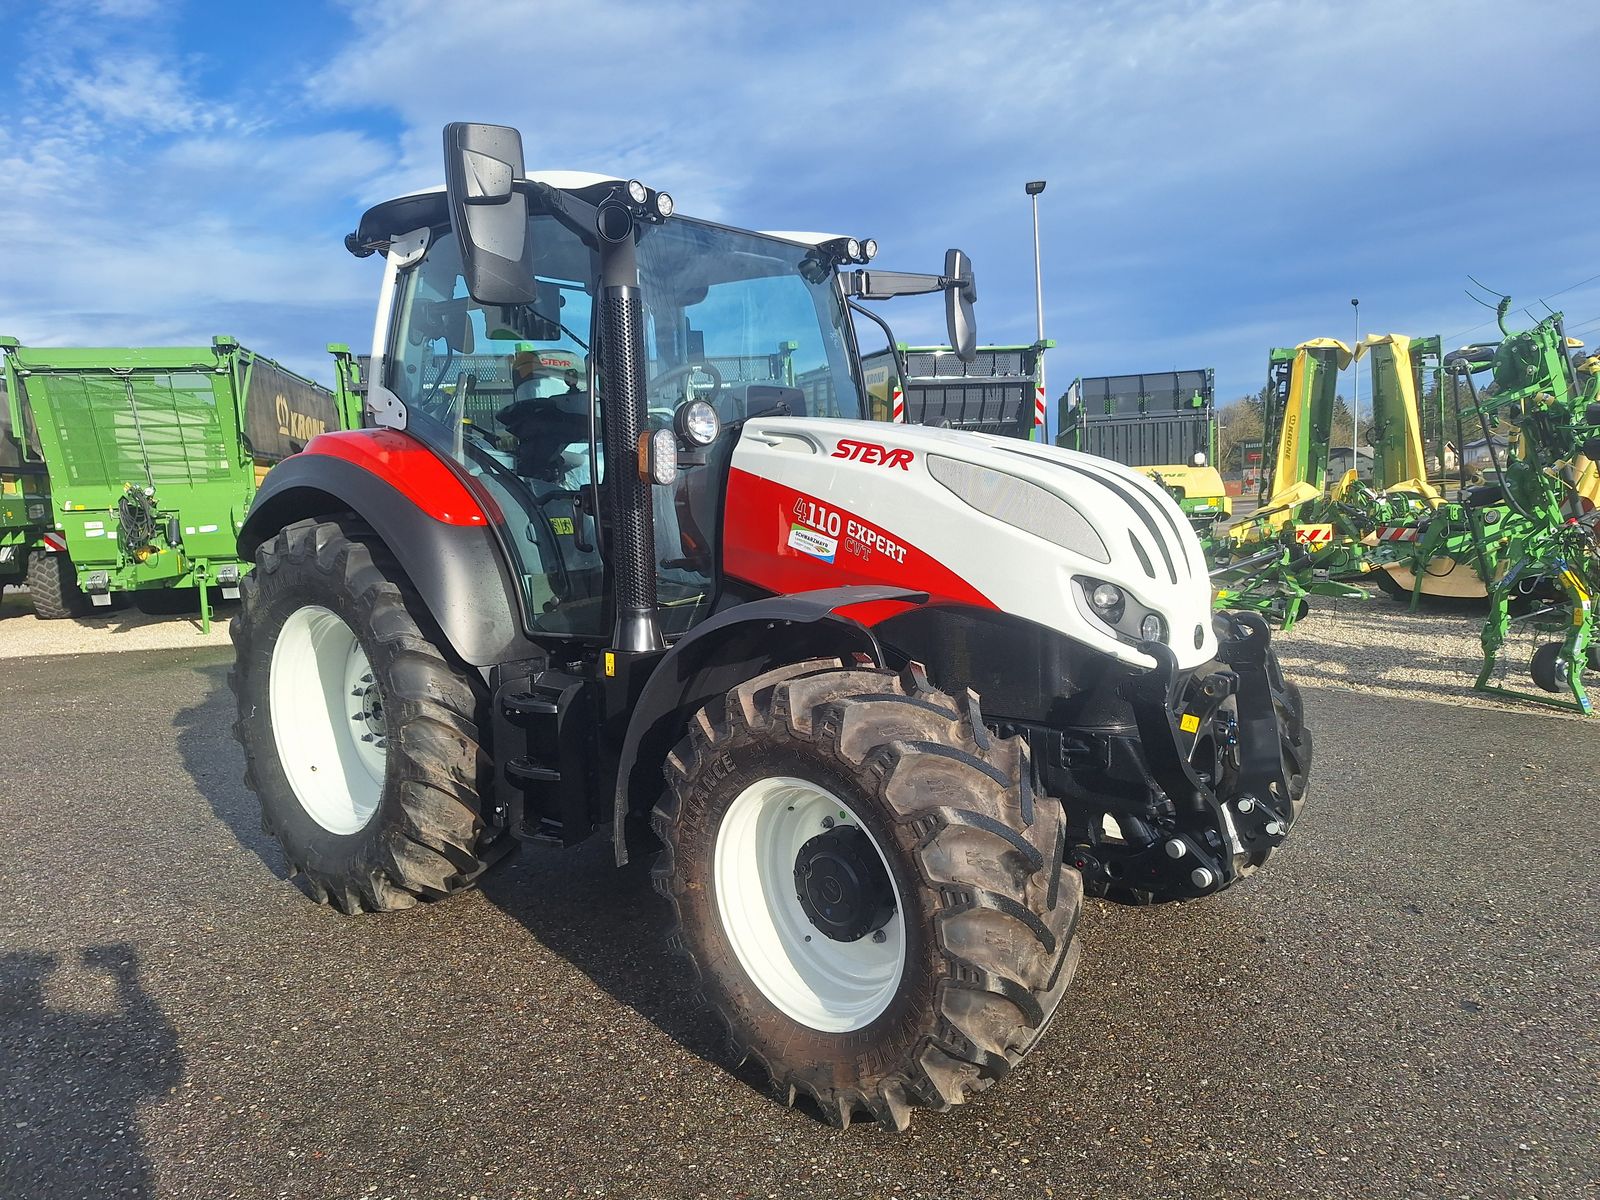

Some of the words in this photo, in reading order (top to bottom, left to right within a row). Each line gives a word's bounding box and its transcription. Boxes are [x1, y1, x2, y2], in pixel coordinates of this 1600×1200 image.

[541, 358, 572, 367] STEYR
[831, 438, 915, 472] STEYR
[1285, 425, 1295, 460] KRONE
[793, 497, 841, 537] 4110
[844, 536, 872, 562] CVT
[846, 519, 907, 564] EXPERT
